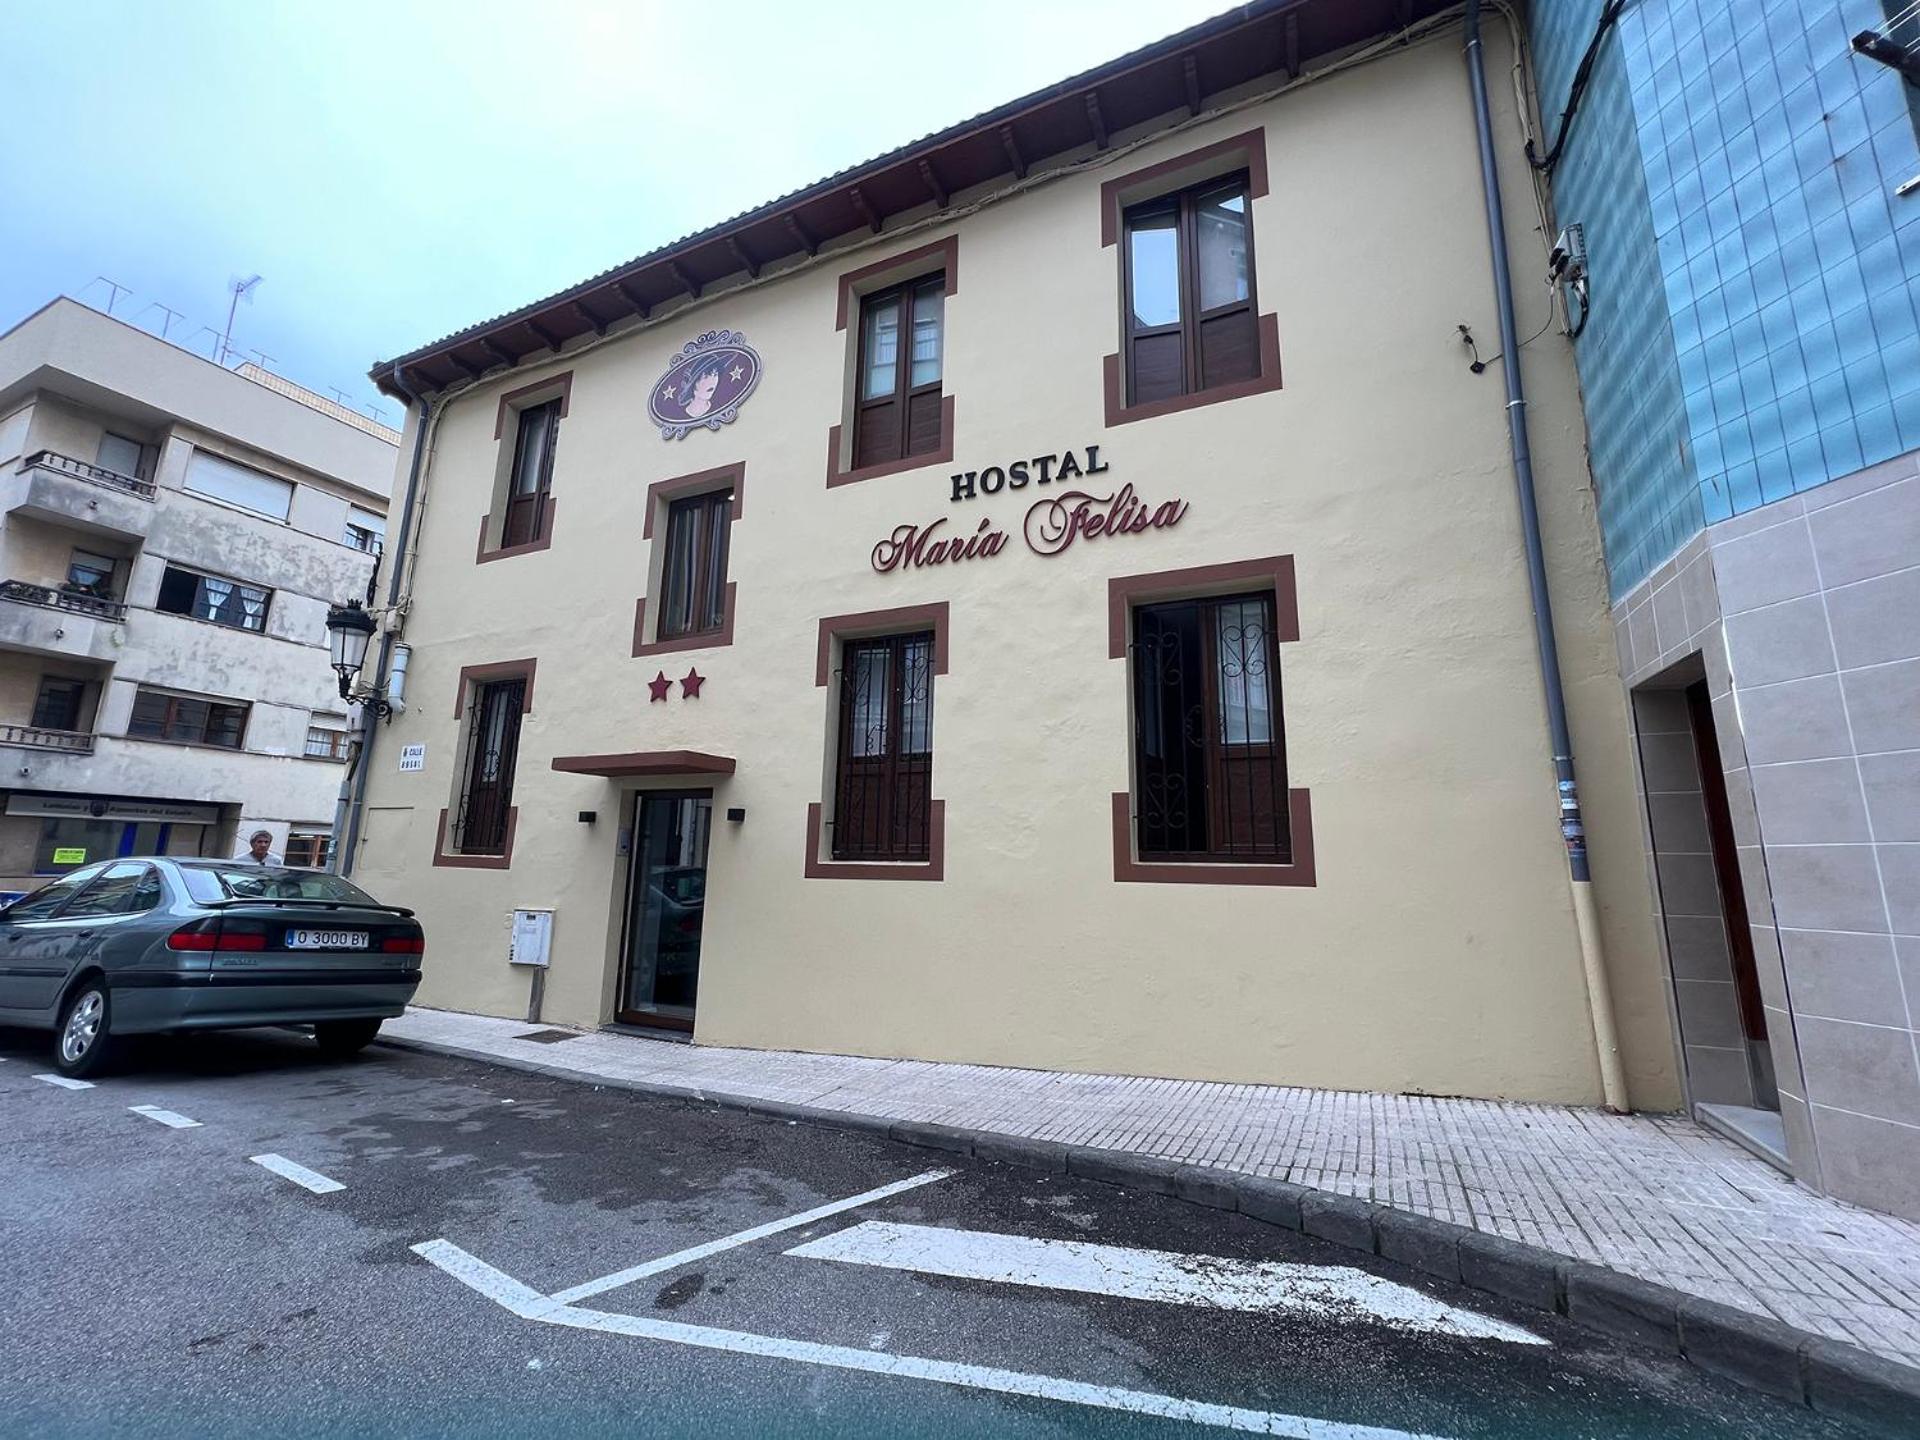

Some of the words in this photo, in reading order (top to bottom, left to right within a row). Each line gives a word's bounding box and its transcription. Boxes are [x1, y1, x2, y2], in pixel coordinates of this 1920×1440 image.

[950, 445, 1109, 501] HOSTAL
[871, 516, 1010, 573] María
[1023, 482, 1189, 555] Felisa
[312, 931, 348, 945] 3000
[352, 933, 367, 946] BY
